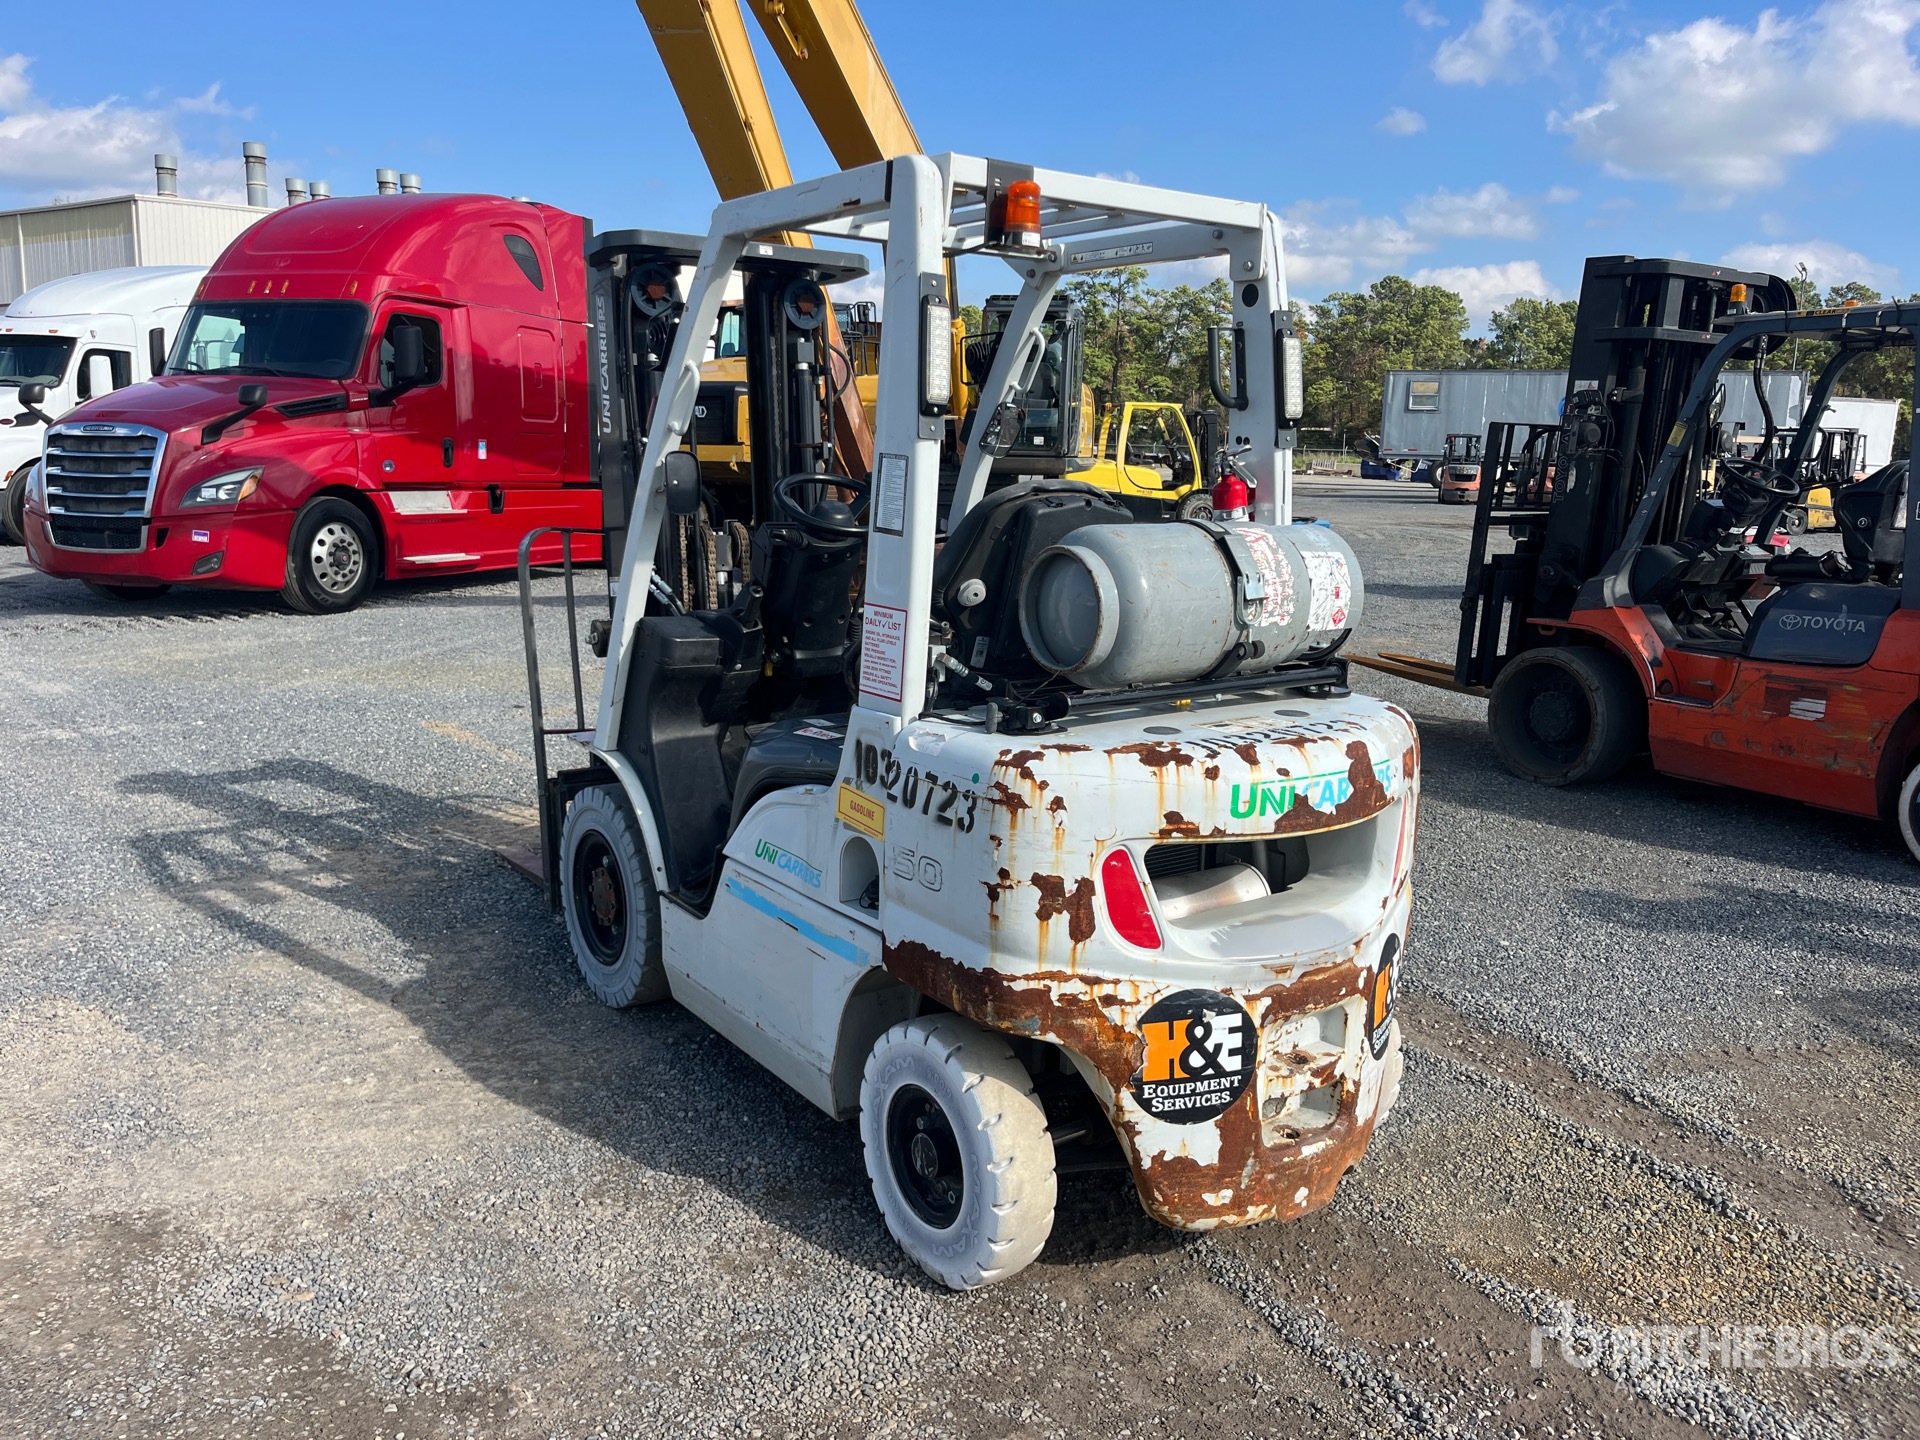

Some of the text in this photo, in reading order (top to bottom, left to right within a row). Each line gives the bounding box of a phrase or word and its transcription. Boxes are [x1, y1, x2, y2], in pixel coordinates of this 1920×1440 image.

[595, 294, 612, 434] UNICARRIERS
[865, 617, 901, 631] DAILY LIST
[873, 610, 894, 619] MINIMUM
[1802, 615, 1866, 633] TOYOTA
[849, 800, 875, 821] GASOLINE
[1141, 1012, 1243, 1082] H&E
[1142, 1075, 1242, 1099] EQUIPMENT
